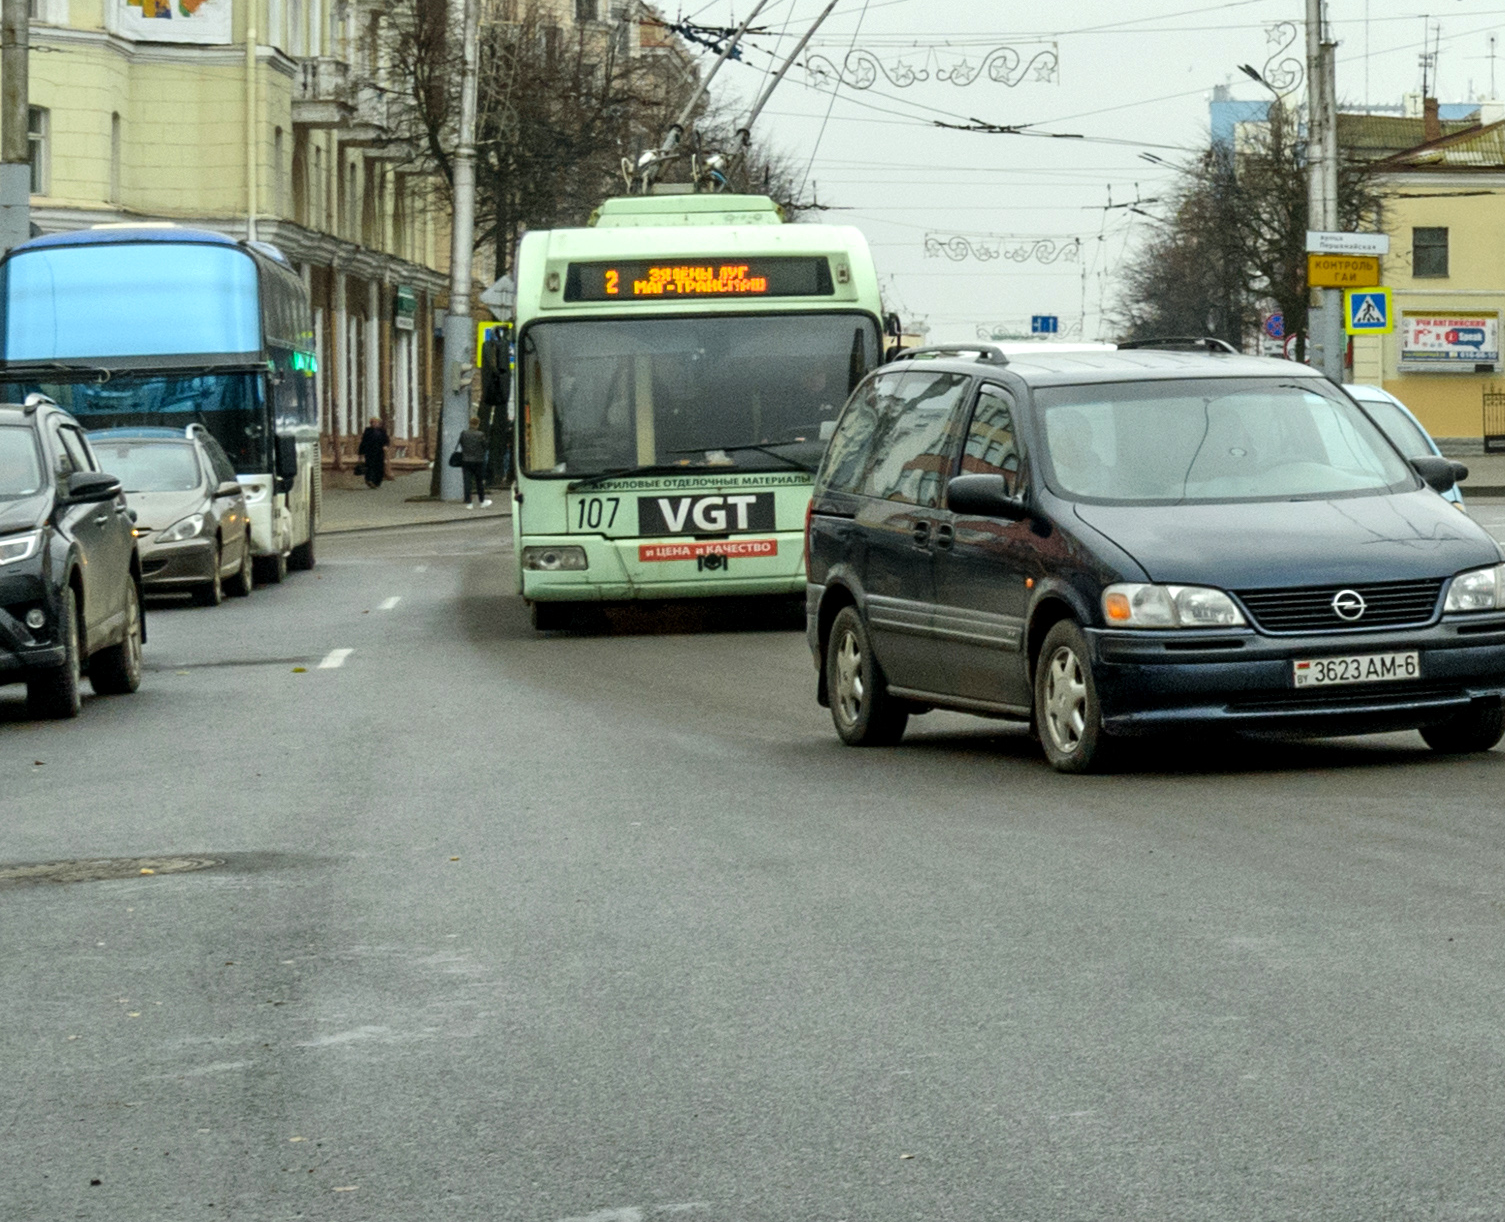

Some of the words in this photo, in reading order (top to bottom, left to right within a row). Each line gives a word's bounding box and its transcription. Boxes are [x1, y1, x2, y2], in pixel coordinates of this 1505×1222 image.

[1315, 260, 1374, 271] КОНТРОЛЬ
[605, 269, 619, 294] 2
[1334, 273, 1357, 281] ГАИ
[663, 477, 740, 489] ОТДЕЛОЧНЫЕ
[742, 475, 811, 486] МАТЕРИАЛЫ
[578, 498, 620, 529] 107
[658, 495, 757, 533] VGT
[656, 547, 691, 558] ЦЕНА
[706, 543, 771, 555] КАЧЕСТВО
[1314, 659, 1362, 683] 3623
[1366, 654, 1416, 679] AM-6
